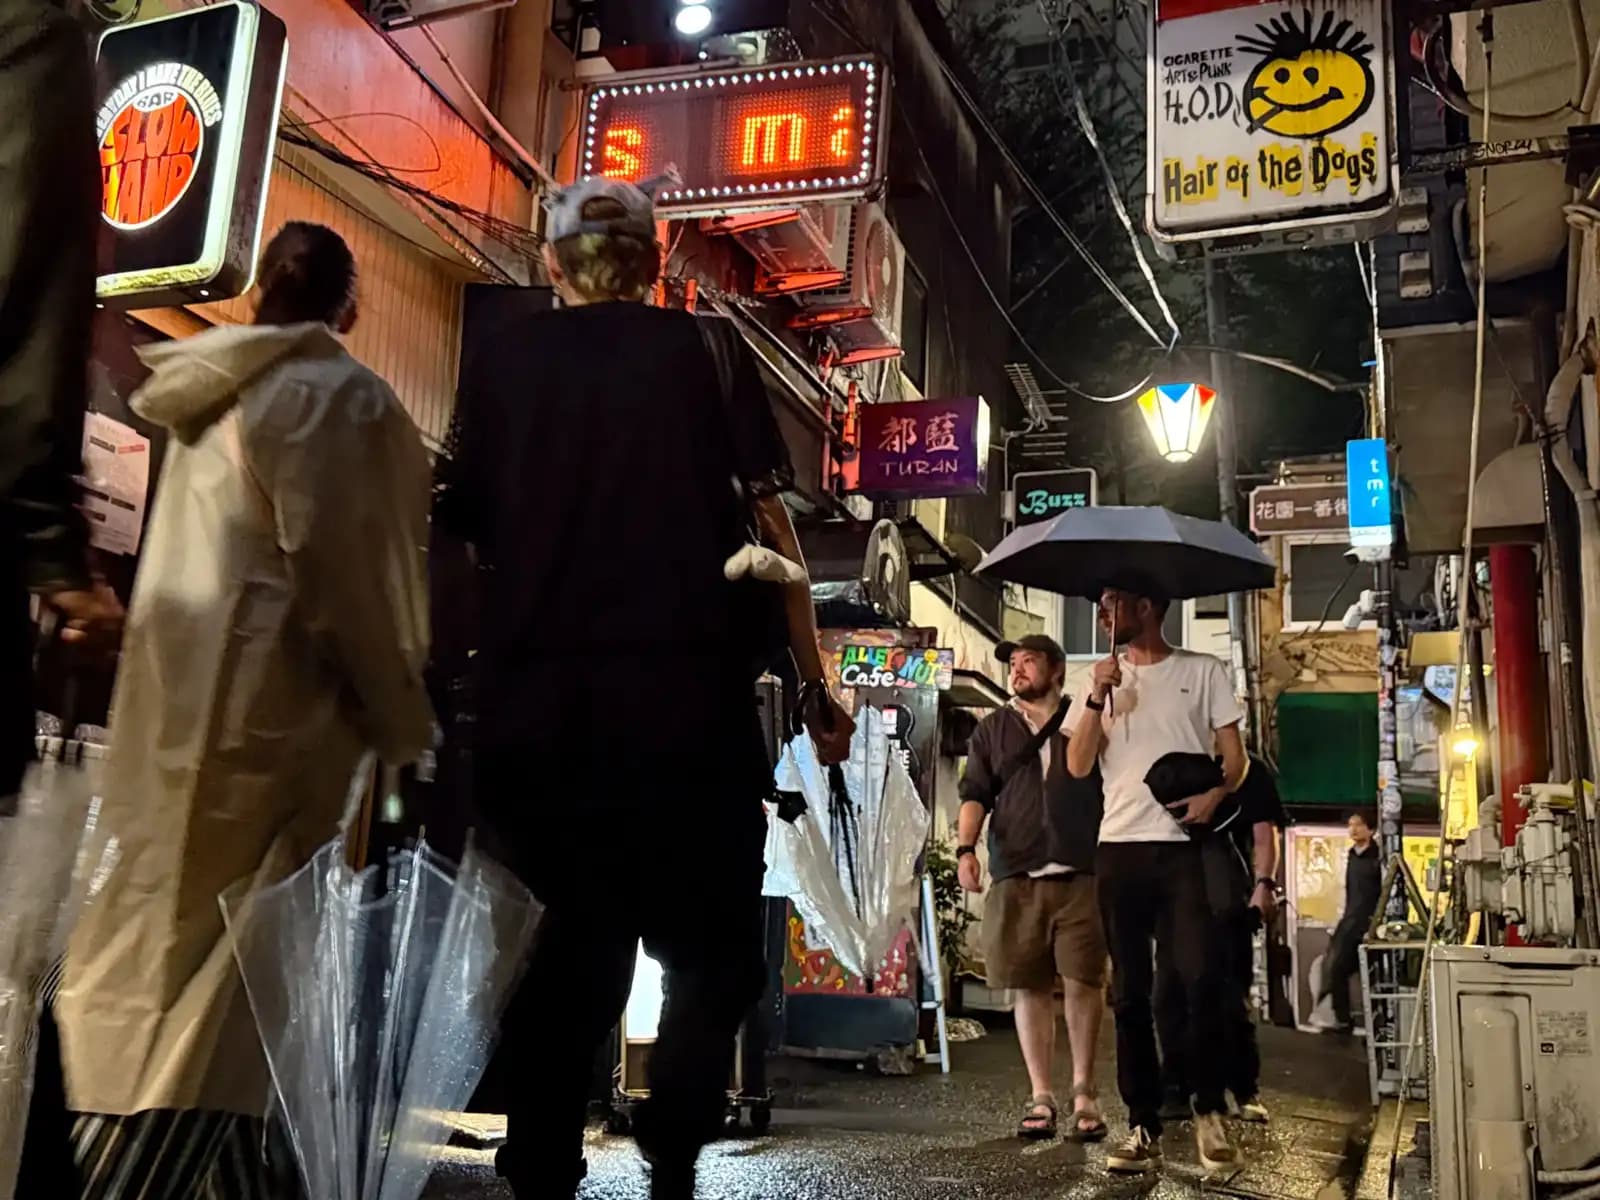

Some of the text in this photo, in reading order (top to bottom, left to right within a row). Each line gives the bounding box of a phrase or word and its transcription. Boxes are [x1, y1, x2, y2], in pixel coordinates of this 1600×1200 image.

[1163, 47, 1234, 67] CIGARETTE
[137, 92, 175, 109] BAR
[101, 92, 201, 167] SLOW
[1163, 146, 1377, 204] Hair of the Dogs
[102, 153, 194, 224] HAND
[878, 411, 960, 454] 都藍
[879, 458, 959, 476] TURAN
[1019, 489, 1086, 515] Buzz
[841, 646, 904, 671] ALLEY
[841, 664, 896, 688] Cafe
